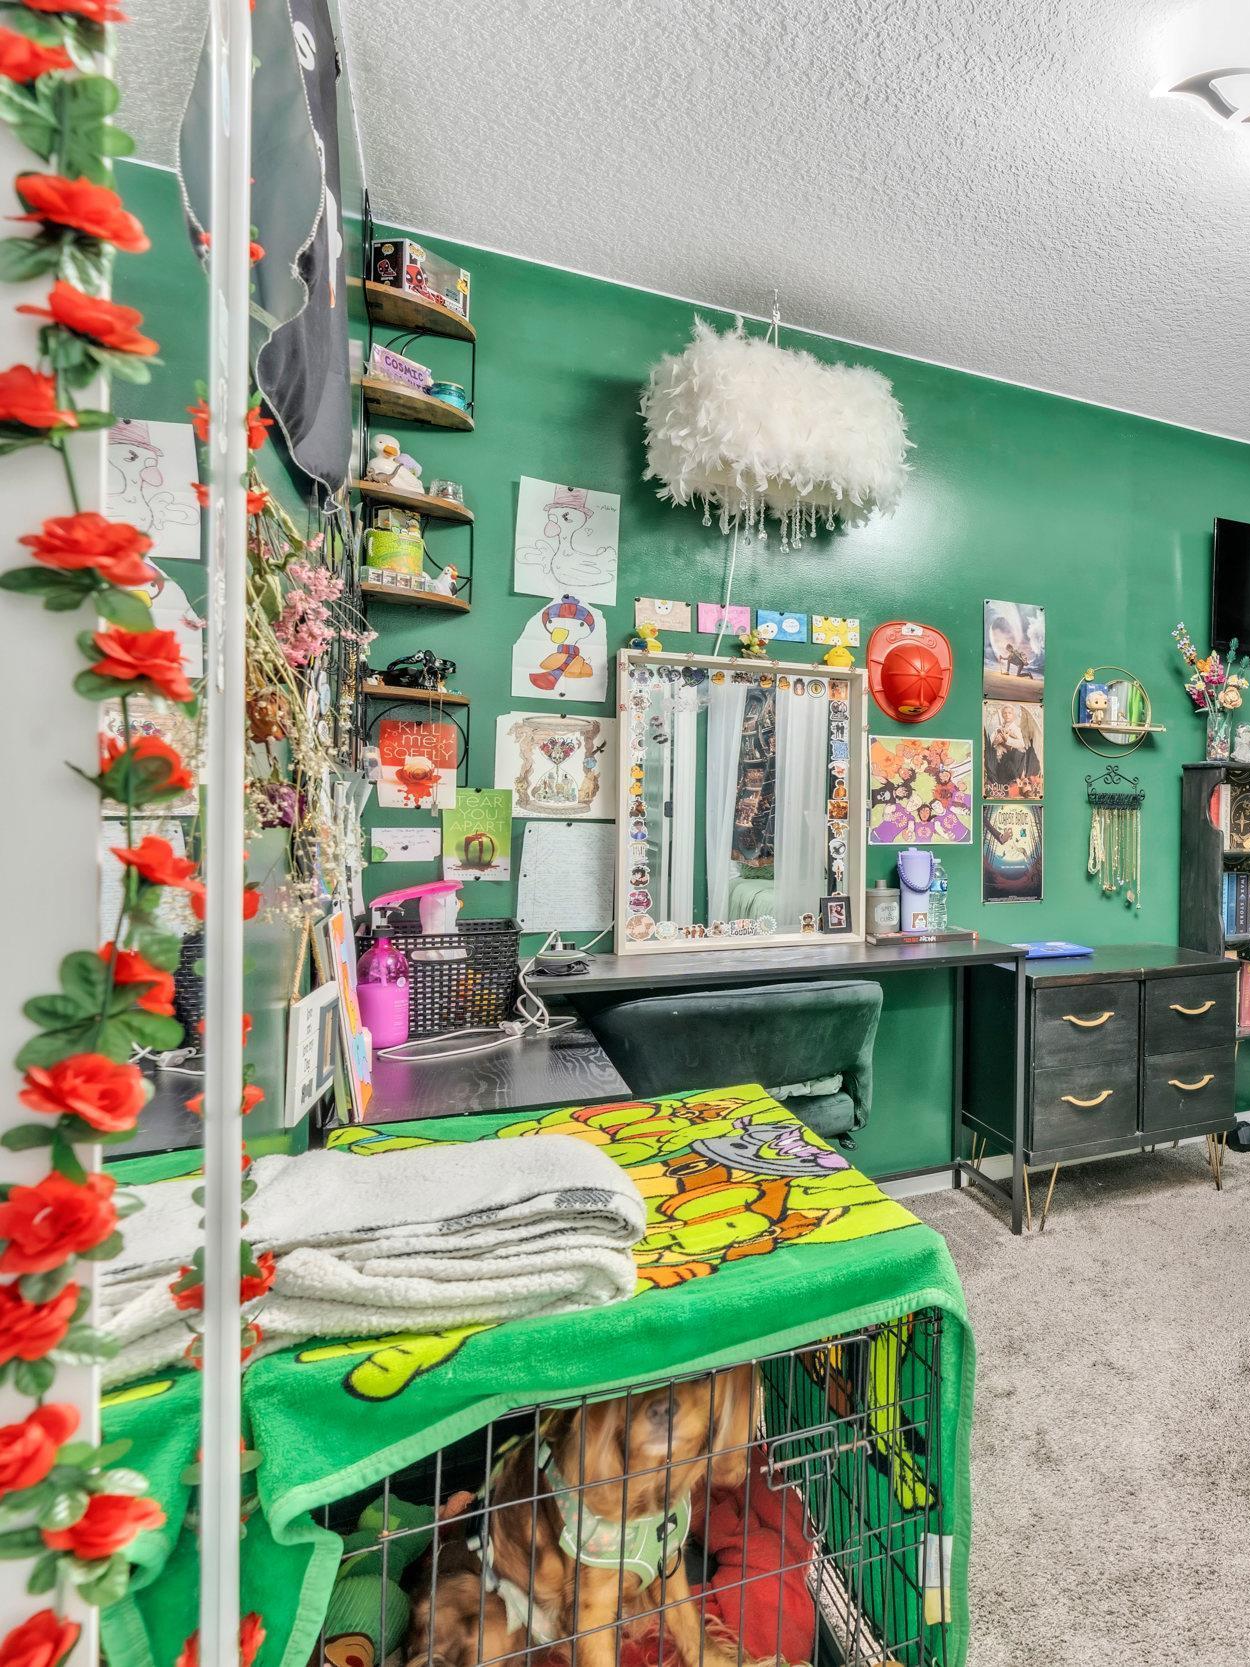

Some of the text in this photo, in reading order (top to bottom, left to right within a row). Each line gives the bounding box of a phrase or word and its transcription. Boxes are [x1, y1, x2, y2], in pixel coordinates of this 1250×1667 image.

[384, 355, 424, 382] COSMIC
[398, 721, 440, 735] KILL
[402, 734, 437, 747] me
[383, 746, 454, 761] SOFTLY
[459, 808, 498, 820] YOU
[449, 820, 506, 832] APART
